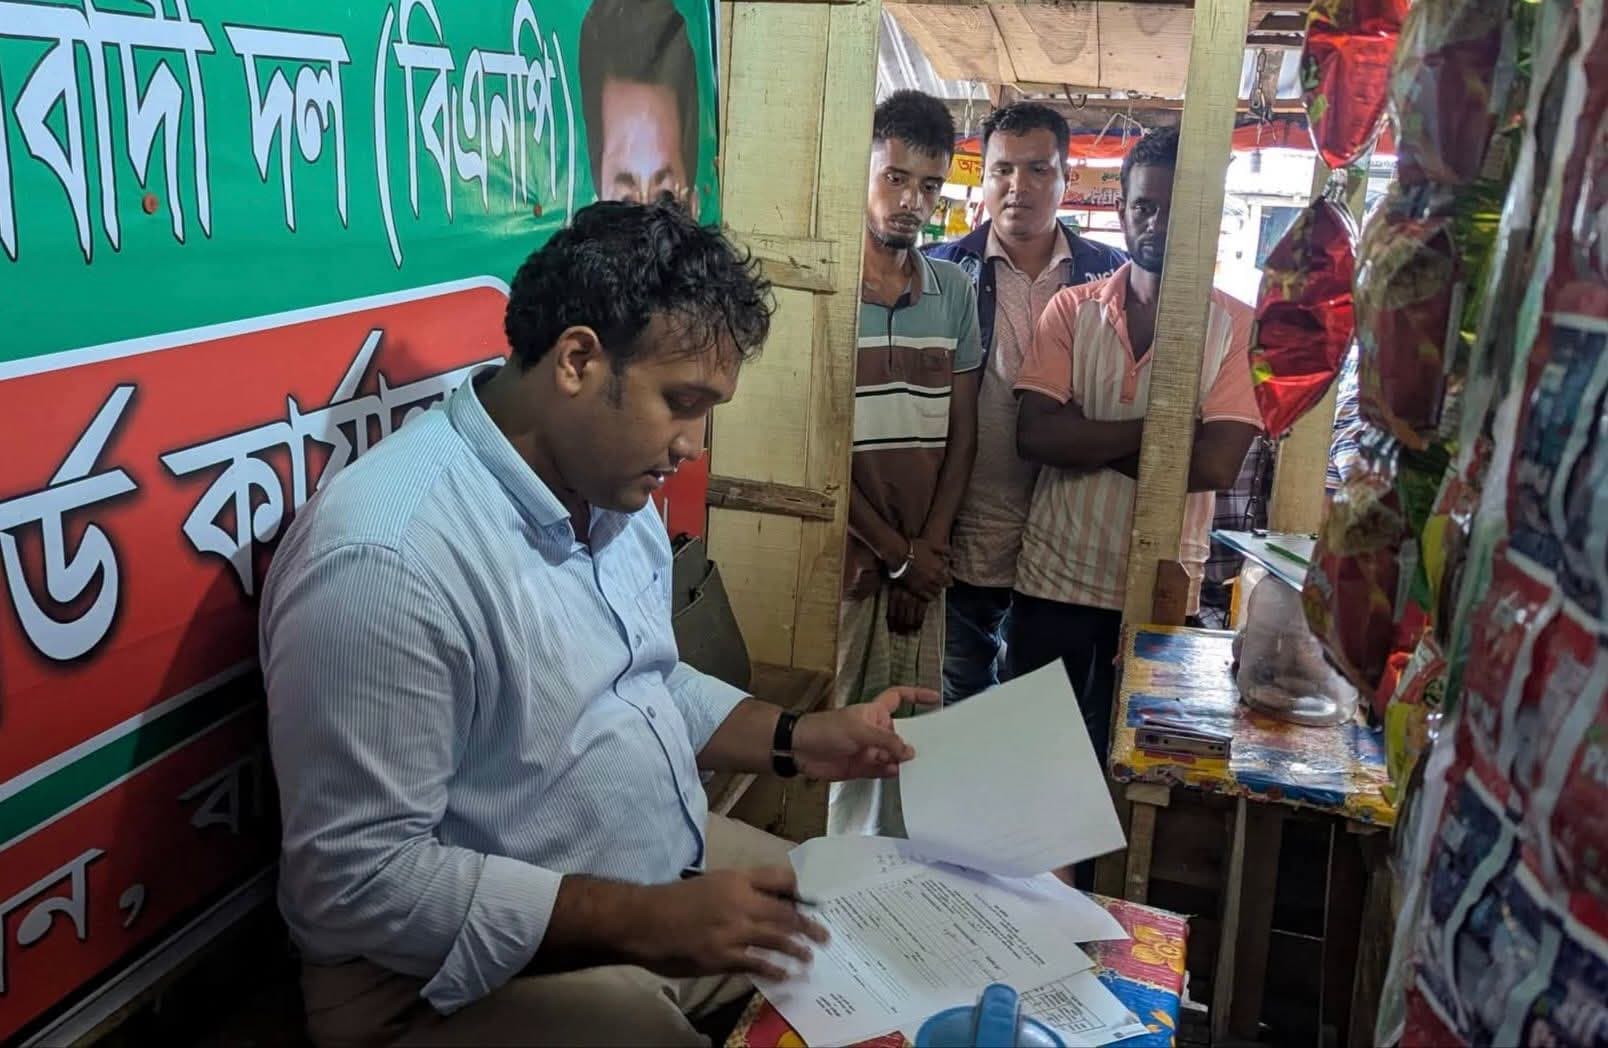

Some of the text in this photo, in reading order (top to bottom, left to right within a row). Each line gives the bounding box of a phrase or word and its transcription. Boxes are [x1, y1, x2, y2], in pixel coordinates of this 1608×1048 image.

[223, 24, 352, 232] দল
[372, 0, 576, 269] (বিএনপি)
[161, 328, 507, 597] কার্যা
